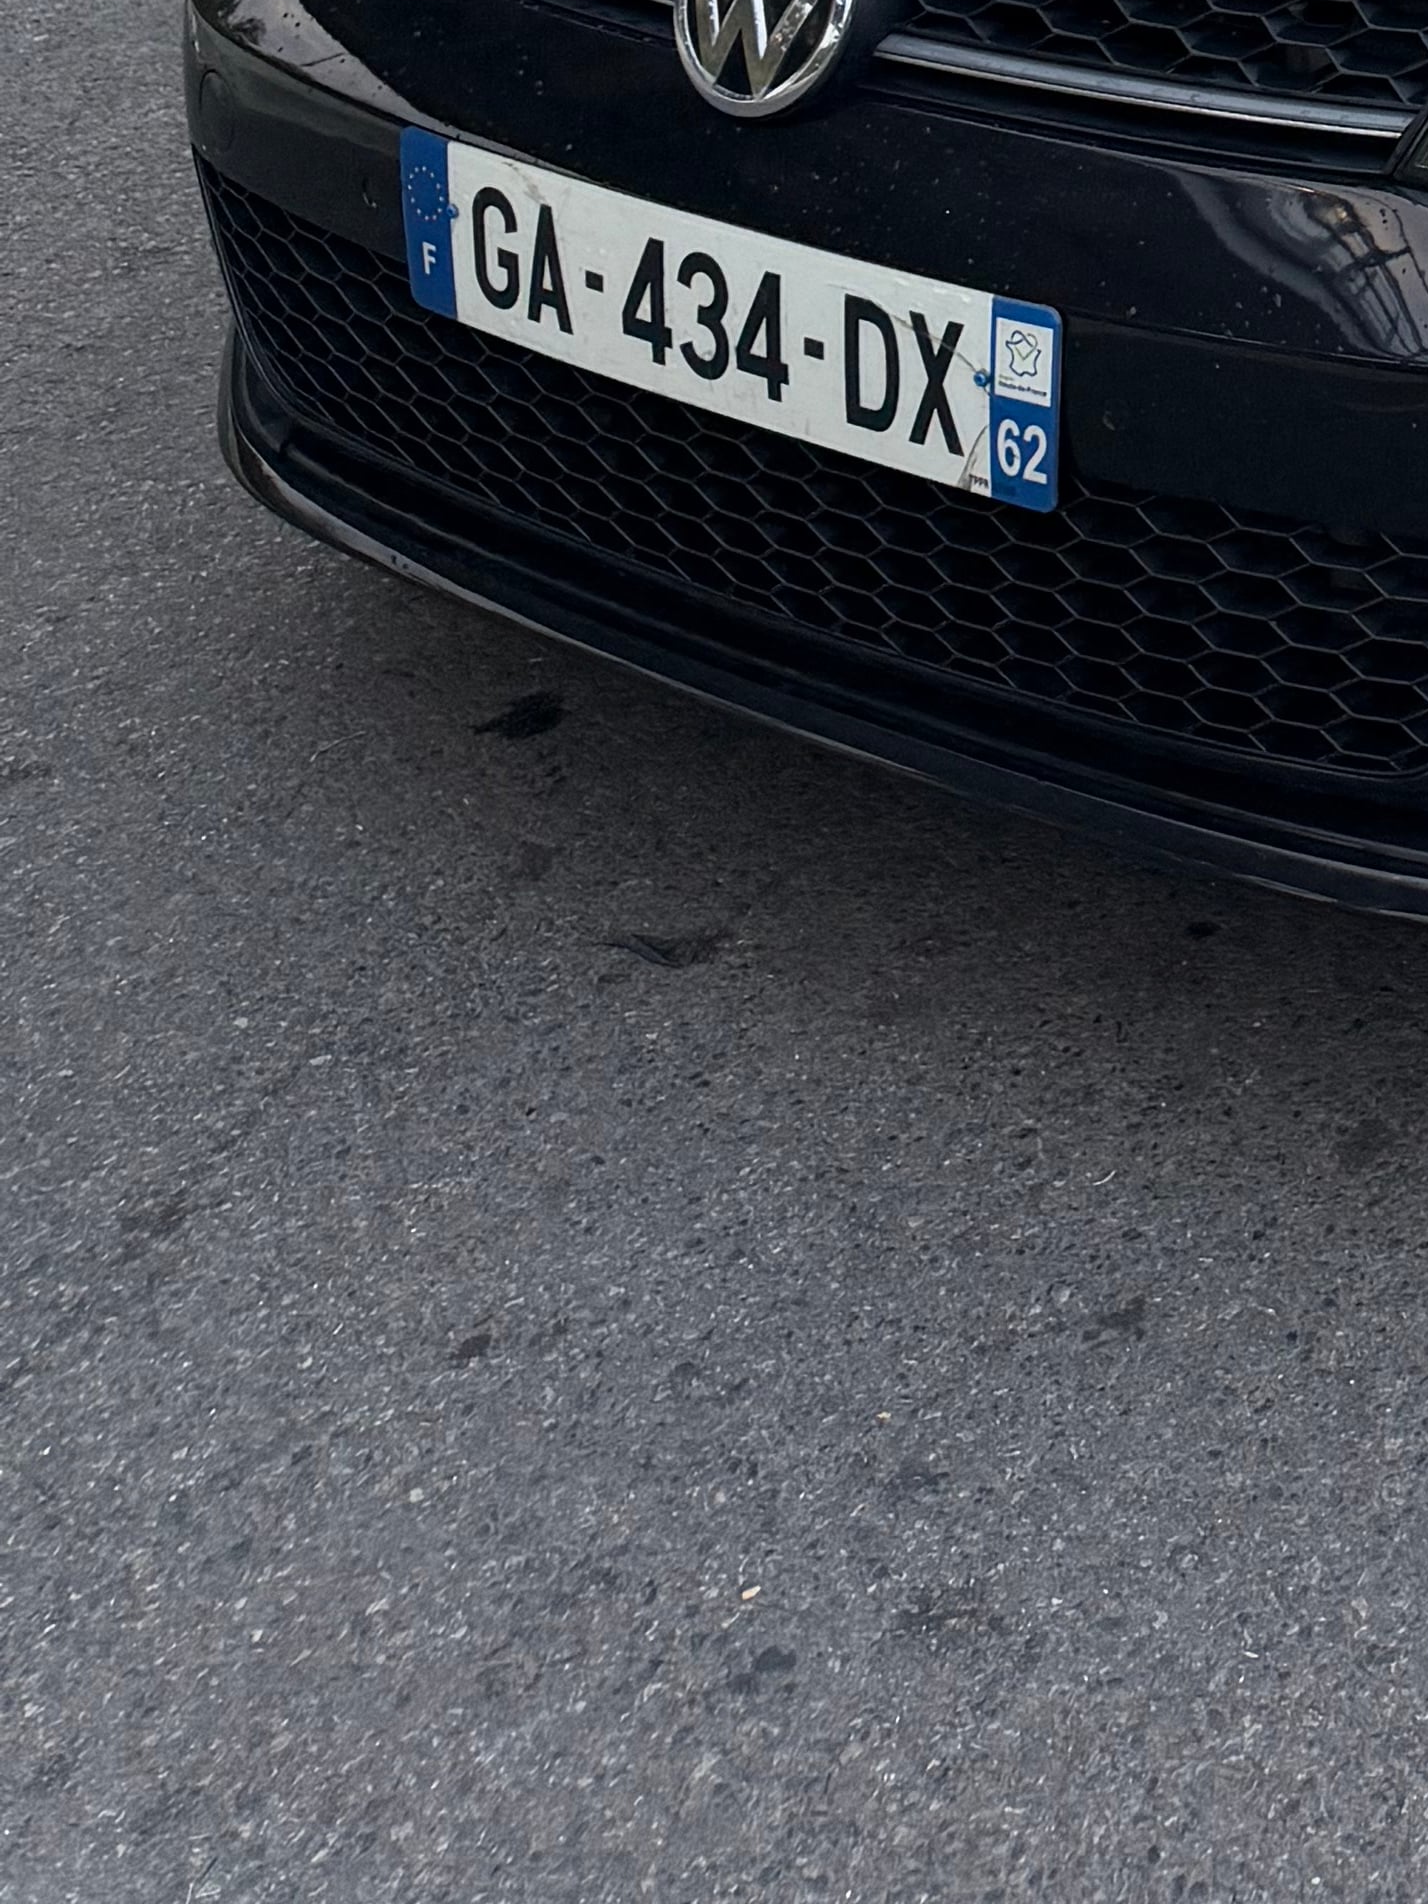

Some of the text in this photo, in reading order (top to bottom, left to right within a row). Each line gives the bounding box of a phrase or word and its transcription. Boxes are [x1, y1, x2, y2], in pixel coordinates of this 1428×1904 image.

[422, 241, 437, 275] F
[471, 186, 964, 458] GA-434-DX
[997, 418, 1048, 485] 62
